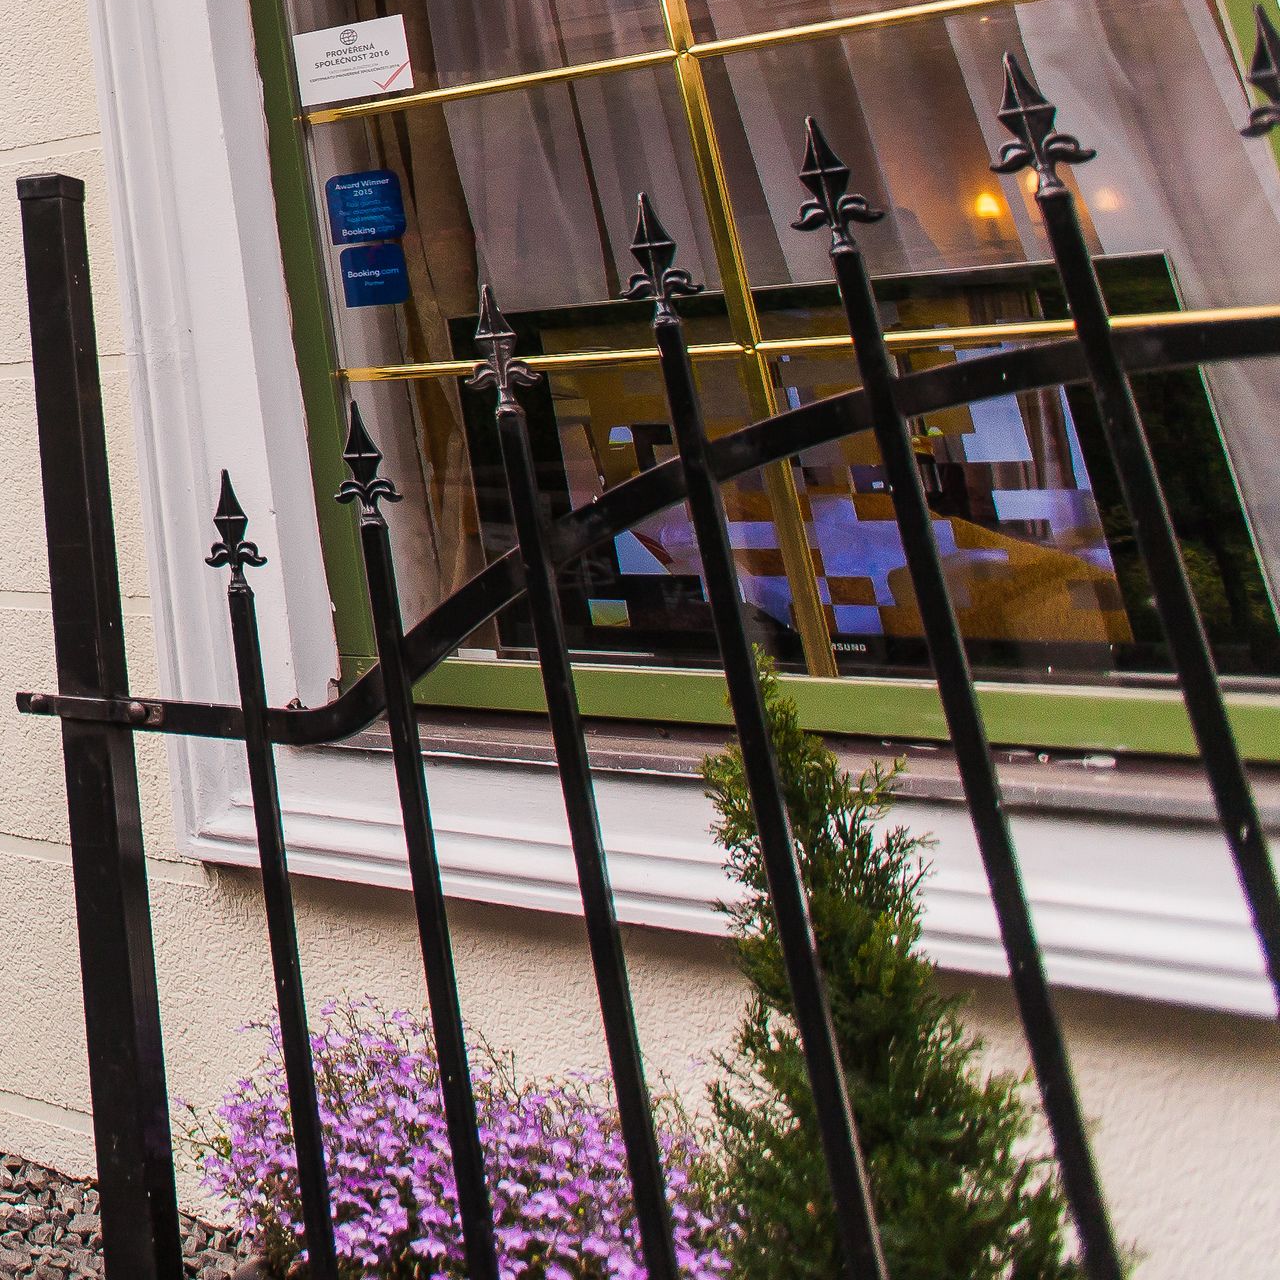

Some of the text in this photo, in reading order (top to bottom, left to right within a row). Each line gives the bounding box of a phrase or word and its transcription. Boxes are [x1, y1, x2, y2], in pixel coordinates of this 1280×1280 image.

[314, 53, 368, 69] SPOLEČNOST
[369, 49, 390, 59] 2016
[335, 179, 390, 190] Award Winner
[353, 188, 374, 197] 2015
[347, 268, 399, 279] Booking.com
